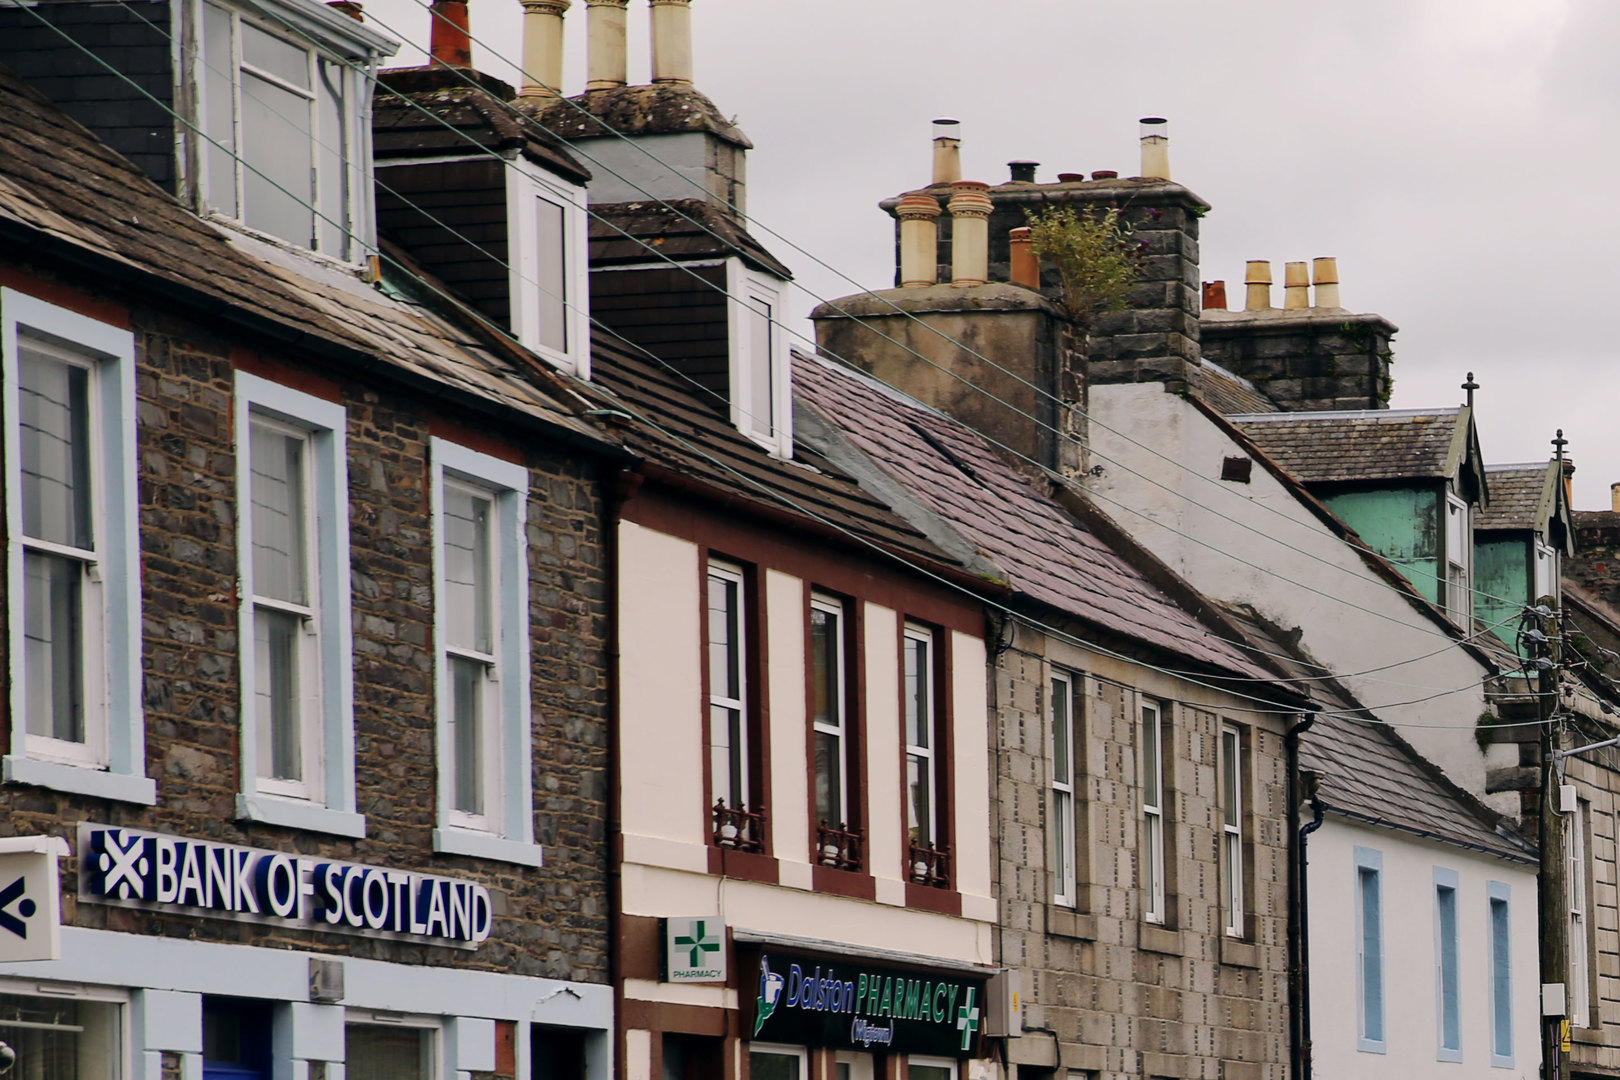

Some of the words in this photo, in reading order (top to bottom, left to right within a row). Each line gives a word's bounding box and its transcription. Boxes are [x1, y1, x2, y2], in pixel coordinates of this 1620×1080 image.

[157, 837, 260, 914] BANK
[267, 853, 315, 920] OF
[325, 863, 493, 943] SCOTLAND
[673, 969, 721, 978] PHARMACY
[786, 963, 854, 1014] Dalston
[855, 973, 959, 1024] PHARMACY
